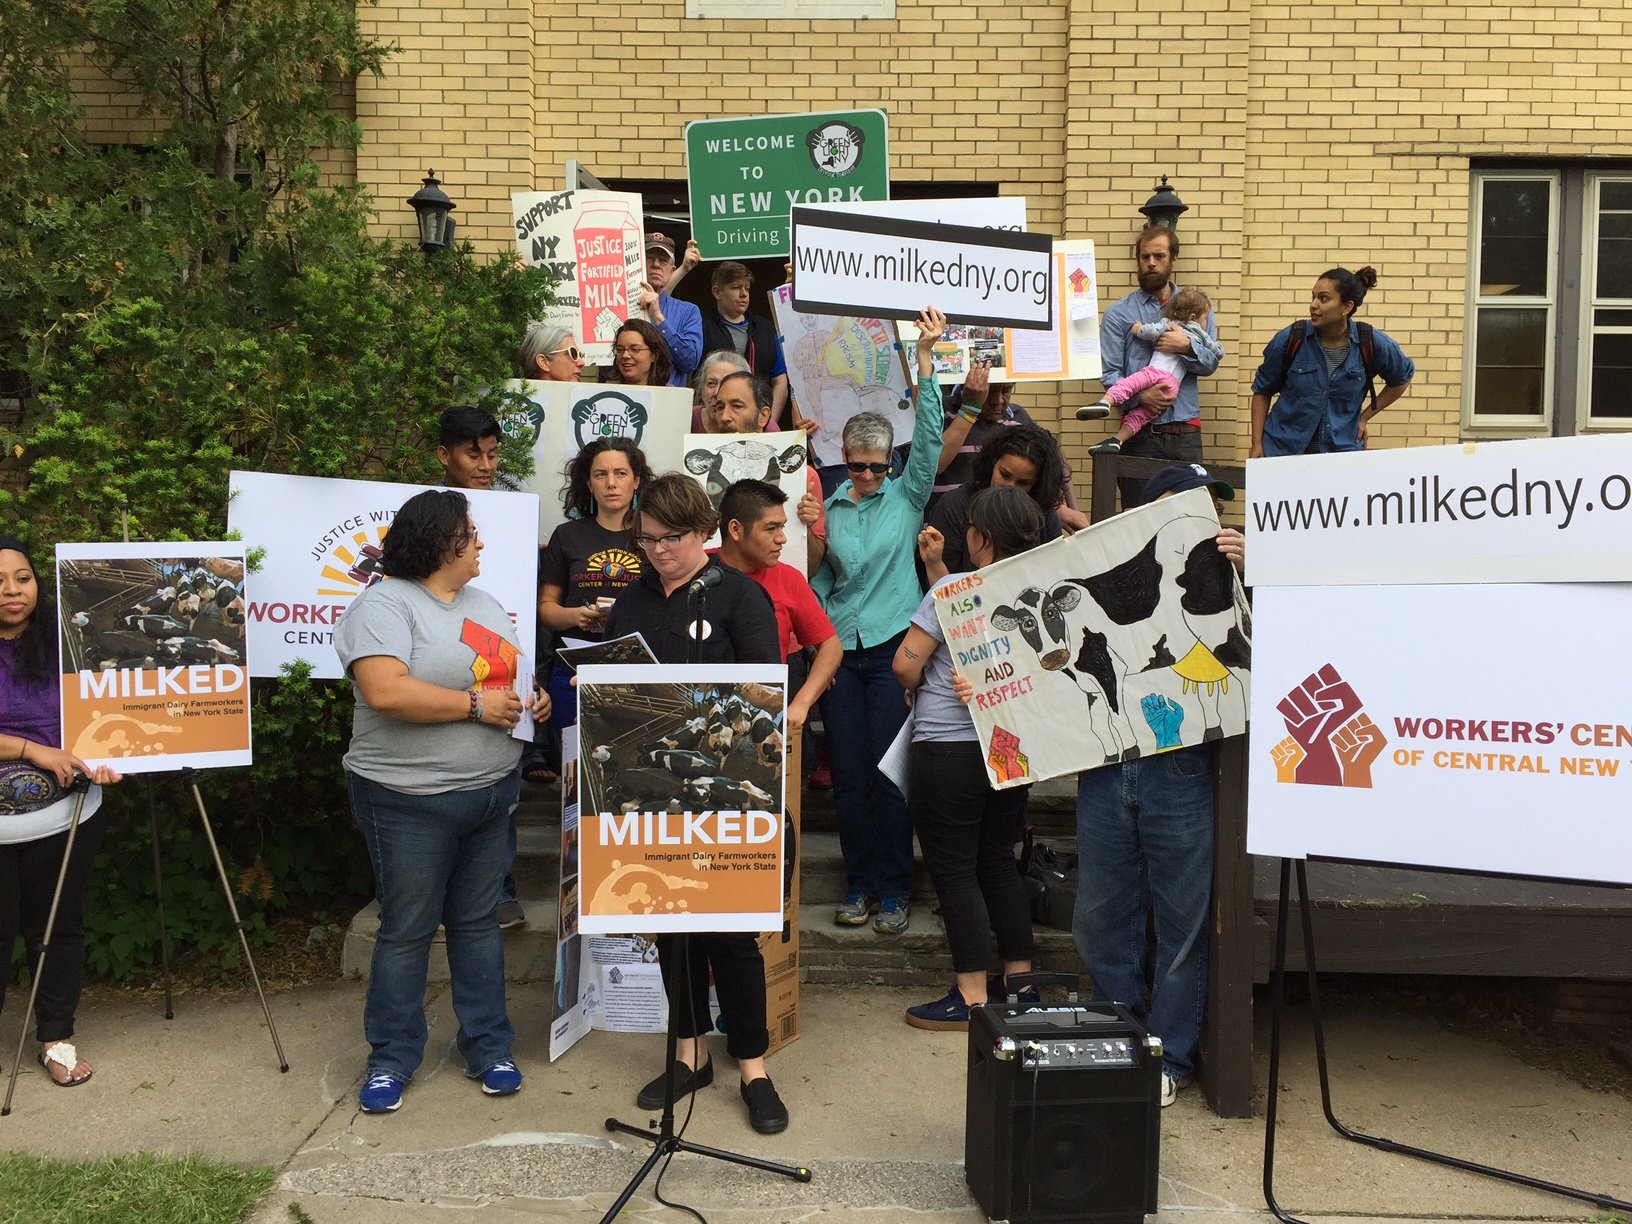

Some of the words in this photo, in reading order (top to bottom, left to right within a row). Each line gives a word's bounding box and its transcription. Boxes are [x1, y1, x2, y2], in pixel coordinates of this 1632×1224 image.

[705, 134, 795, 153] WELCOME
[819, 138, 850, 148] GREEN
[740, 166, 764, 180] TO
[710, 191, 772, 215] NEW
[785, 185, 865, 205] YORK
[515, 190, 575, 241] SUPPORT
[532, 235, 561, 261] NY
[576, 235, 623, 260] JUSTICE
[717, 228, 780, 246] Driving
[581, 262, 624, 282] FORTIFIED
[797, 246, 1048, 305] www.milkedny.org
[584, 281, 626, 309] MILK
[837, 338, 856, 369] RACISM
[589, 412, 629, 428] GREEN
[1252, 468, 1632, 532] www.milkedny.o
[311, 515, 365, 561] JUSTICE
[369, 510, 401, 522] WIT
[620, 574, 641, 582] JUS
[934, 573, 984, 600] WORKERS
[247, 601, 346, 625] WORKE
[950, 594, 983, 617] ALSO
[284, 630, 334, 645] CENT
[948, 614, 988, 641] WANT
[957, 635, 1012, 667] DIGNITY
[79, 663, 244, 700] MILKED
[984, 661, 1015, 684] AND
[123, 701, 165, 712] Immigrant
[167, 700, 188, 711] Dairy
[190, 699, 244, 708] Farmworkers
[975, 675, 1035, 711] RESPECT
[183, 709, 201, 717] New
[203, 708, 221, 716] York
[223, 707, 244, 715] State
[1570, 723, 1632, 748] CEN
[1393, 748, 1425, 767] OF
[1433, 750, 1550, 774] CENTRAL
[1560, 756, 1620, 778] NEW
[600, 810, 778, 846] MILKED
[645, 852, 691, 861] Immigrant
[692, 851, 716, 862] Dairy
[718, 852, 777, 860] Farmworkers
[699, 862, 708, 871] in
[710, 863, 730, 871] New
[731, 862, 751, 871] York
[753, 863, 777, 871] State
